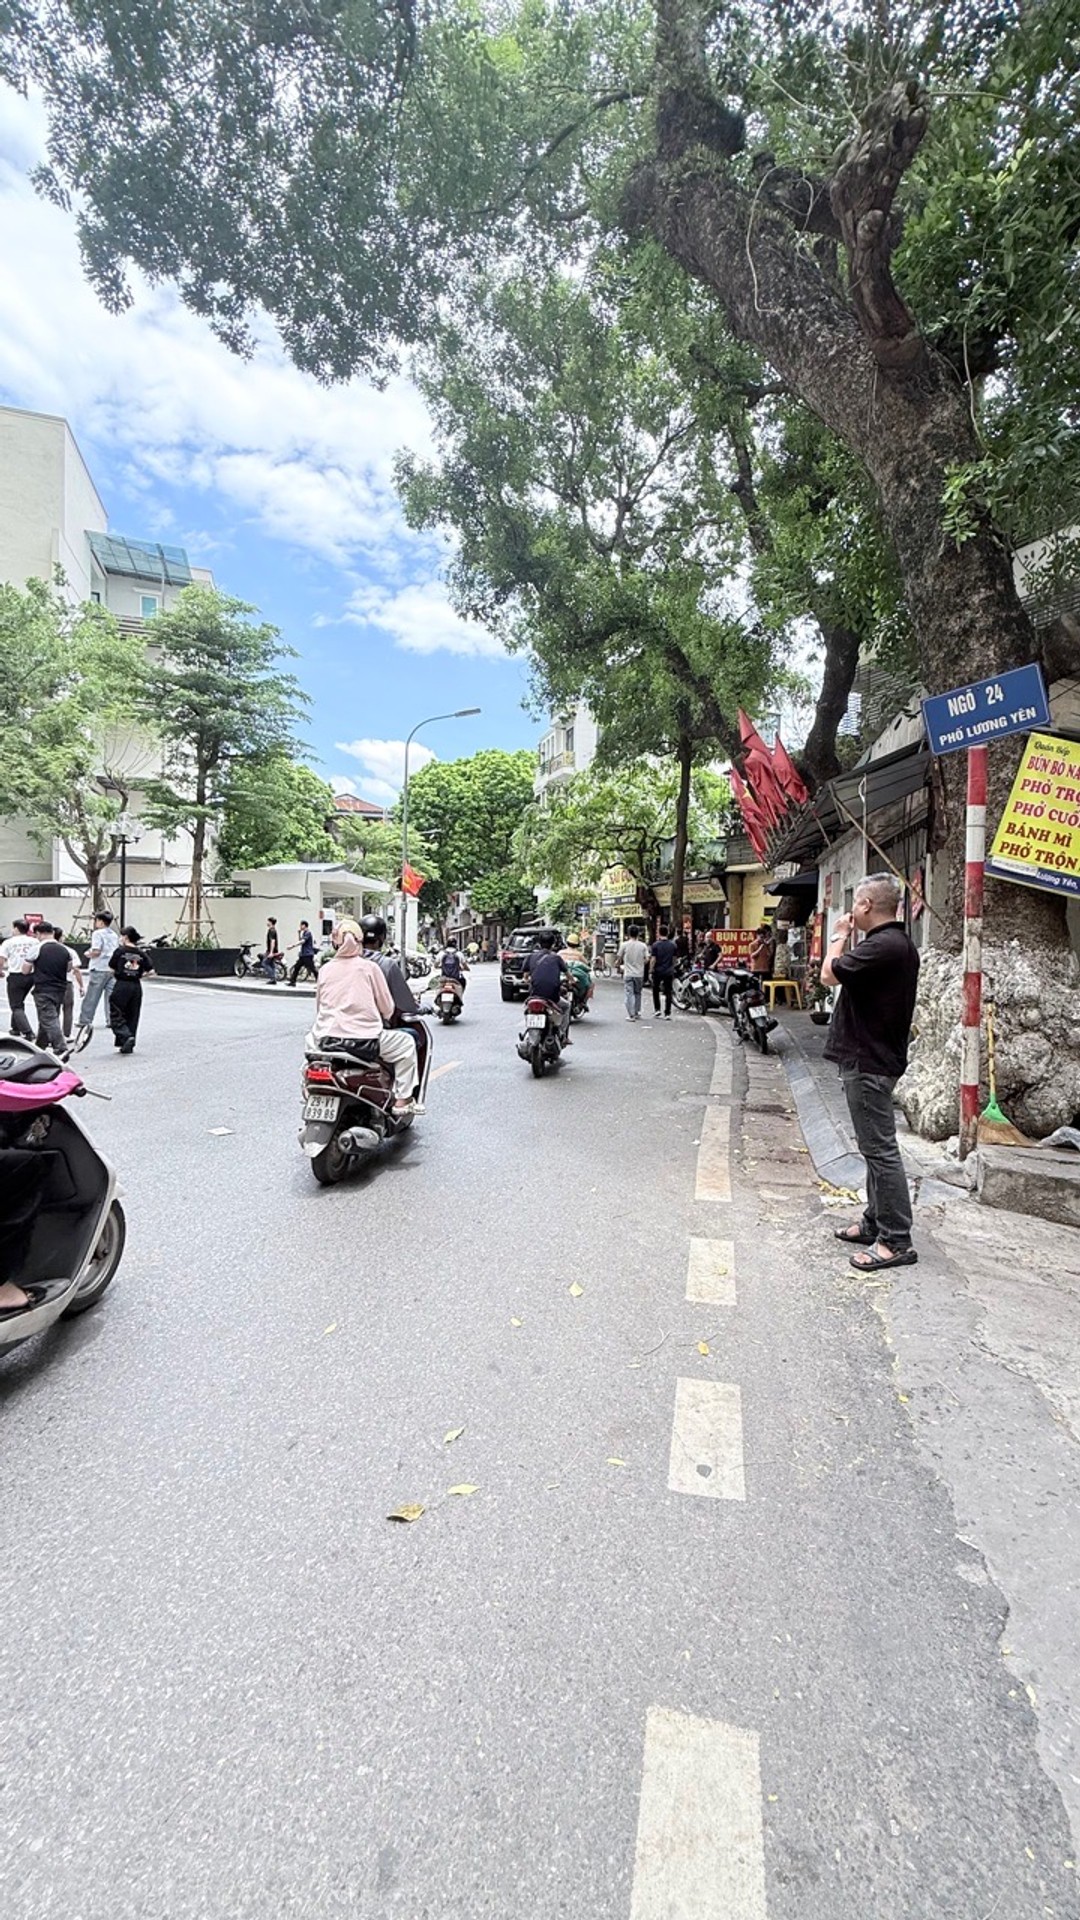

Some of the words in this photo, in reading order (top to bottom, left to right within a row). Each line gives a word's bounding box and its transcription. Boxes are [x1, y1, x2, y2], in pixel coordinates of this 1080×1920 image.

[947, 688, 977, 717] NGÕ
[985, 683, 1005, 705] 24
[939, 726, 964, 746] PHỐ
[966, 715, 1008, 738] LƯƠNG
[1010, 706, 1037, 724] YÊN
[1026, 754, 1051, 772] BÚN
[1050, 759, 1066, 776] BÒ
[1020, 779, 1053, 795] PHỞ
[1012, 801, 1047, 817] PHỞ
[1005, 822, 1052, 842] BÁNH
[1053, 832, 1073, 848] MÌ
[998, 841, 1033, 858] PHỞ
[1034, 851, 1078, 870] TRỘN
